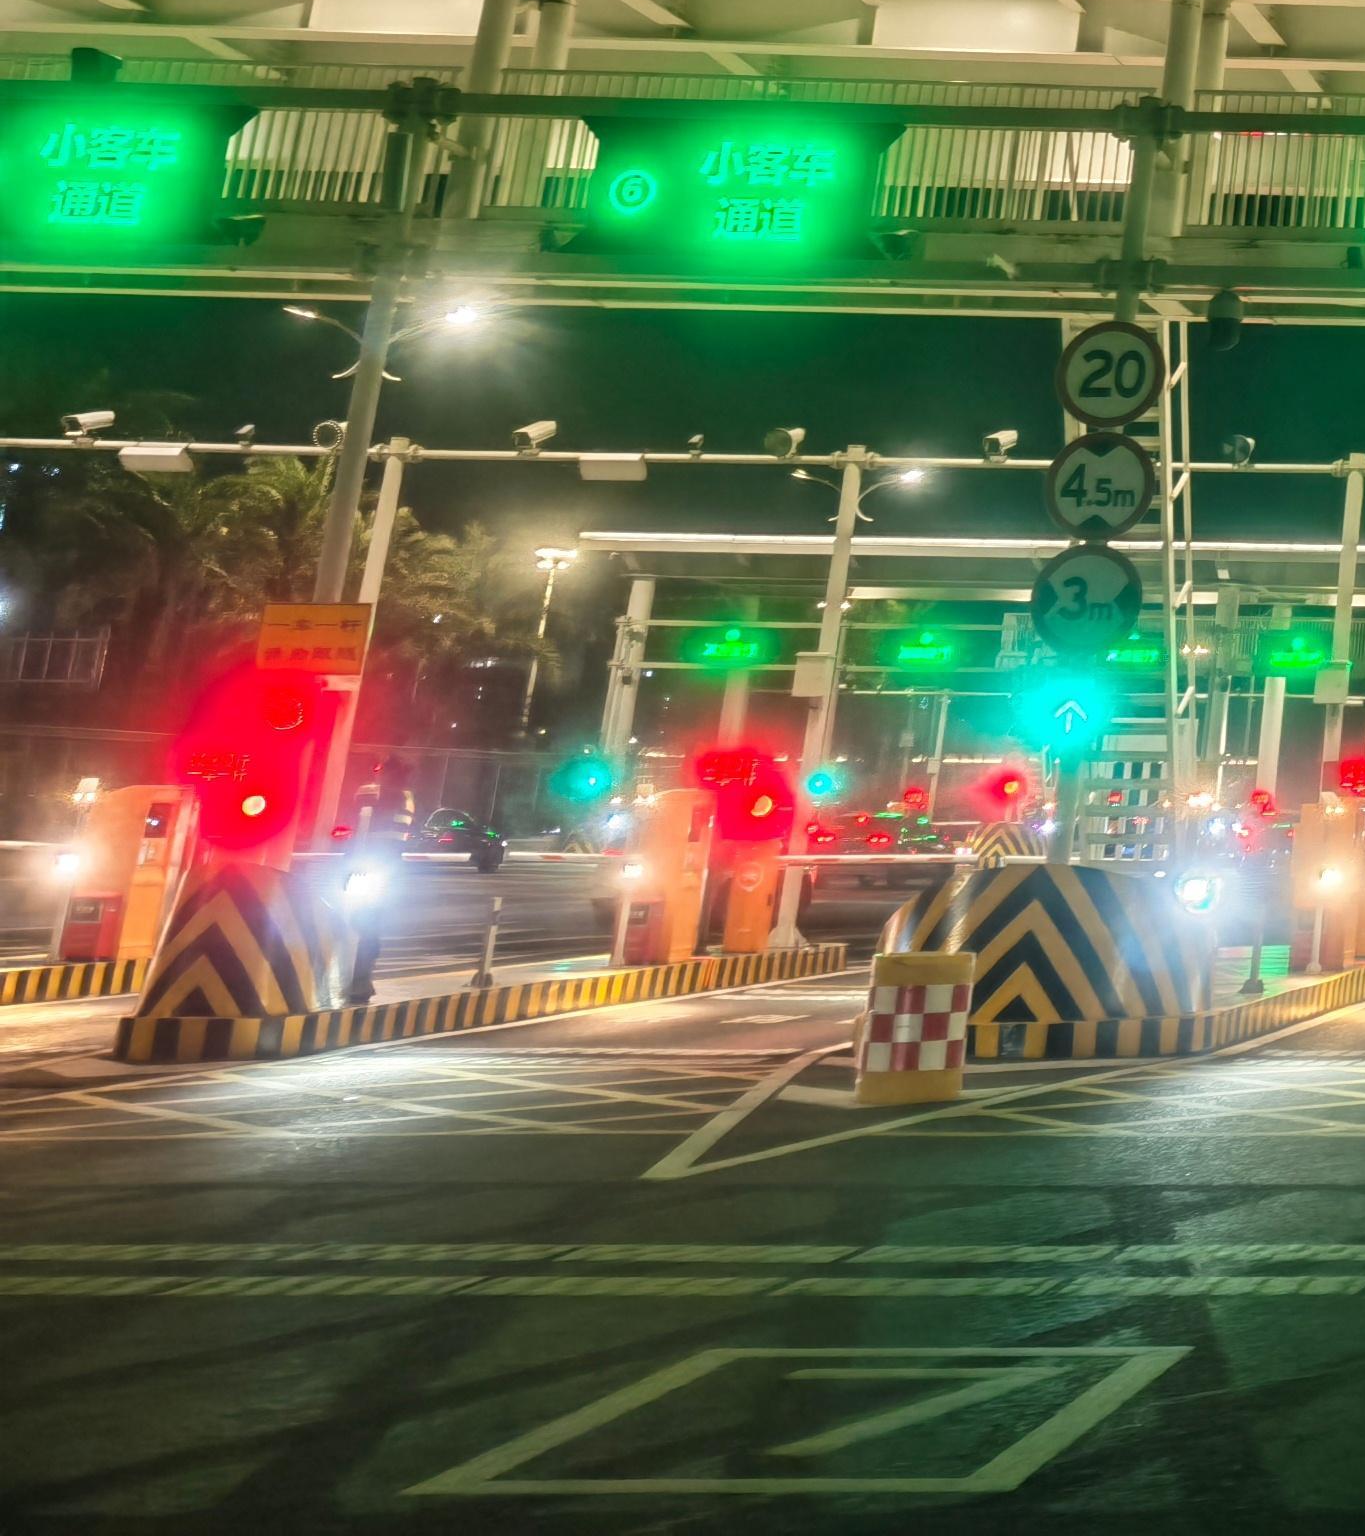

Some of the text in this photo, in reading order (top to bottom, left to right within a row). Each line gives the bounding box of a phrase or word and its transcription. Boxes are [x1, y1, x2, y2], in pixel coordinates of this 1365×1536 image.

[39, 121, 182, 172] 小客车
[699, 141, 837, 187] 小客车
[47, 179, 148, 226] 通道
[711, 197, 806, 242] 通道
[1078, 349, 1147, 399] 20
[1059, 463, 1136, 509] 4.5m
[1058, 575, 1114, 622] 3m
[766, 1366, 1073, 1457] 7
